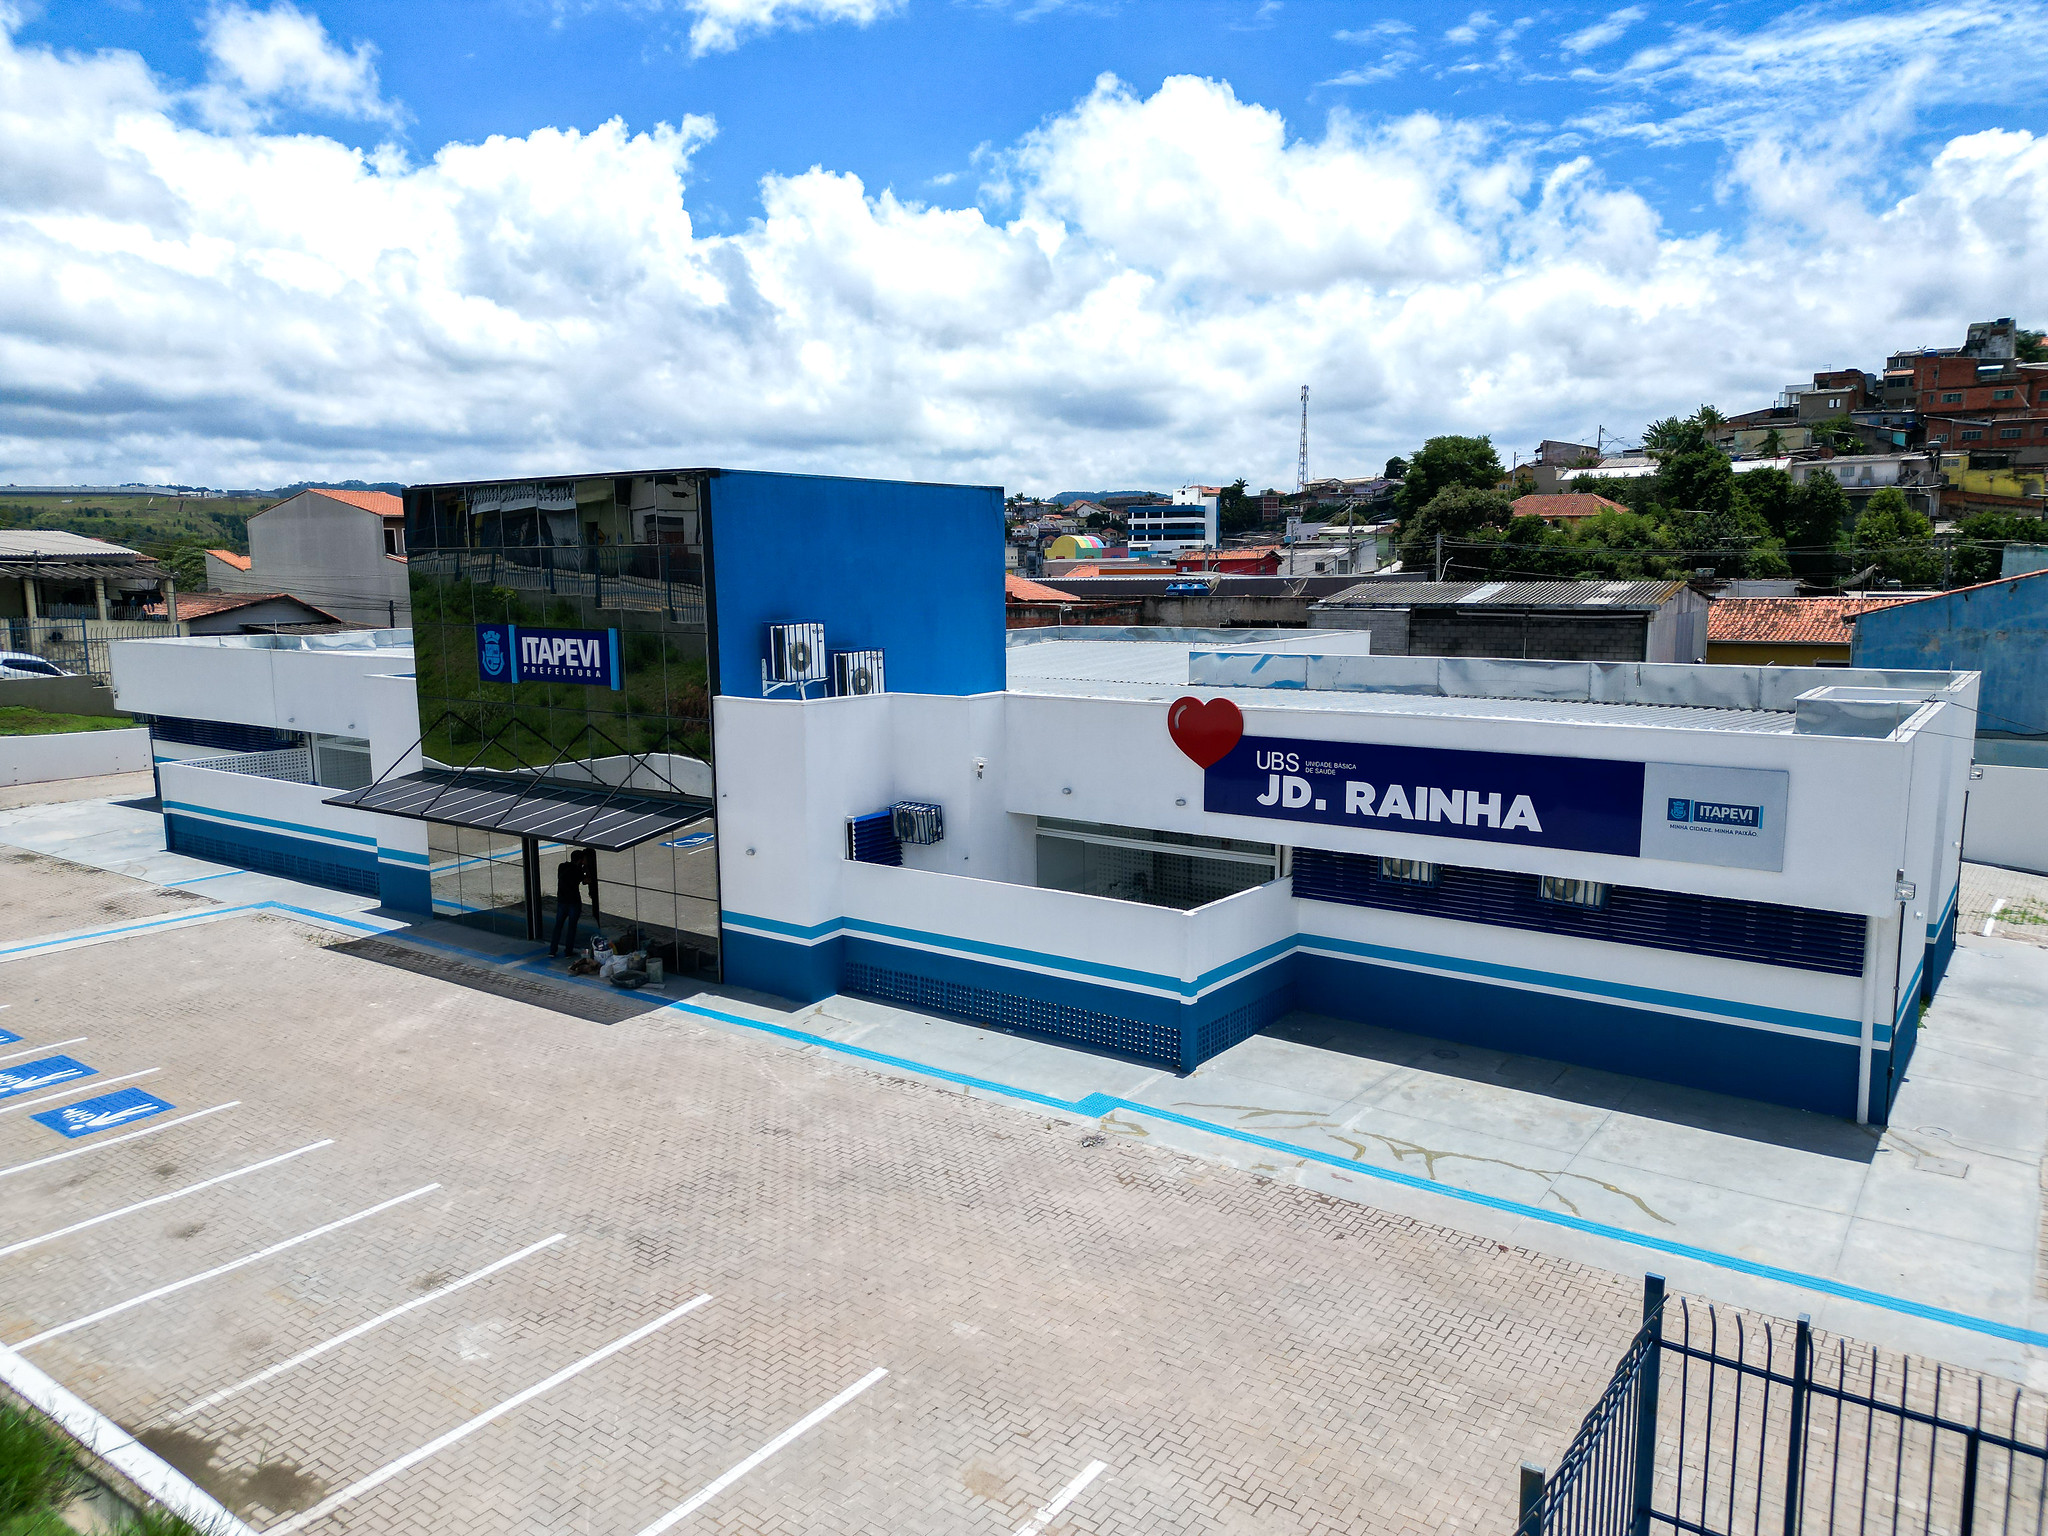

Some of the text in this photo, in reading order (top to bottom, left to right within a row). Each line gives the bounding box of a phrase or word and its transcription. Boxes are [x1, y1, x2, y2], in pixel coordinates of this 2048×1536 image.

[522, 637, 601, 667] ITAPEVI
[523, 666, 601, 677] PREFEITURA
[1256, 750, 1300, 772] UBS
[1305, 760, 1333, 768] UNIDADE
[1256, 774, 1543, 833] JD. RAINHA
[1700, 805, 1753, 820] ITAPEVI
